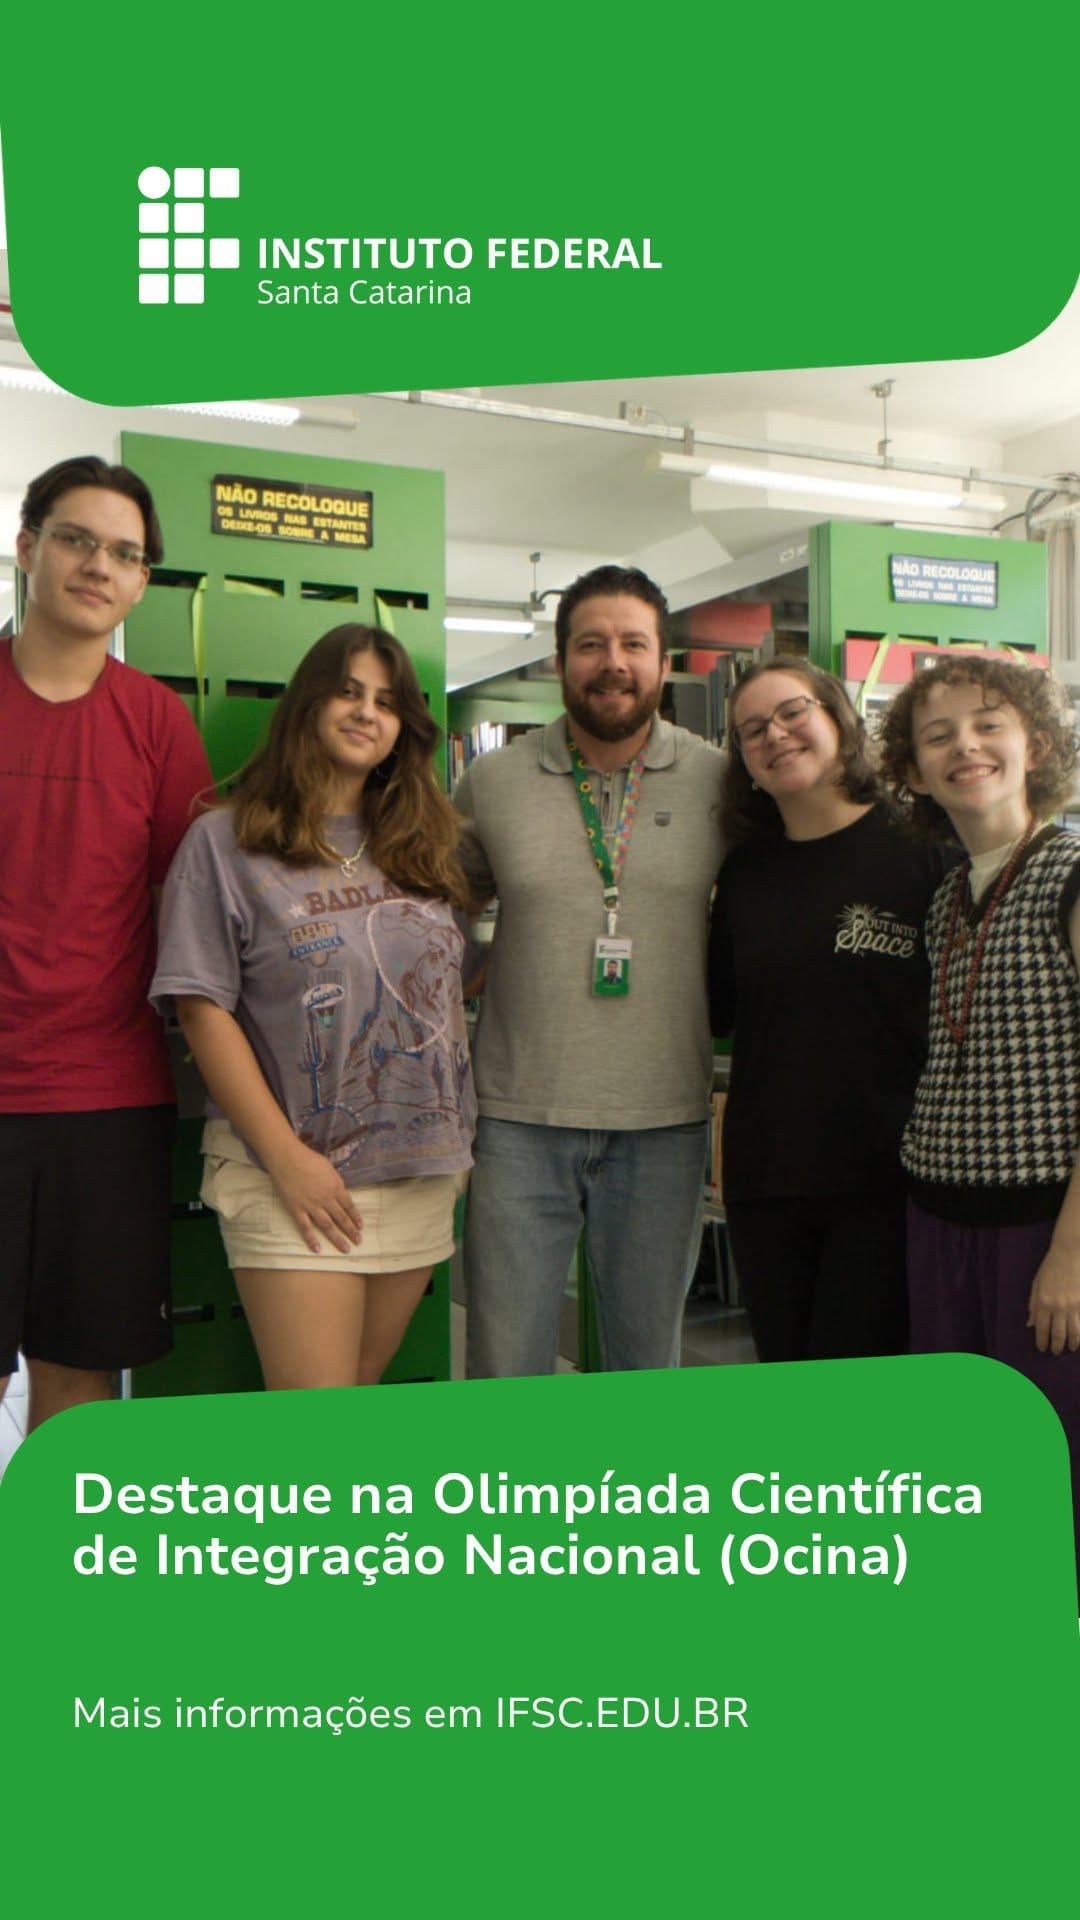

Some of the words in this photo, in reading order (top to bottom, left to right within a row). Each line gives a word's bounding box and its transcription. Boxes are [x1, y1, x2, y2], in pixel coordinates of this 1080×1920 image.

[216, 482, 257, 504] NÃO
[262, 490, 369, 518] RECOLOQUE
[217, 505, 233, 517] OS
[239, 507, 278, 522] LIVROS
[284, 513, 307, 525] NAS
[313, 516, 367, 532] ESTANTES
[221, 518, 272, 534] DEIXE-OS
[278, 525, 315, 539] SOBRE
[320, 530, 329, 541] A
[334, 532, 367, 544] MESA
[892, 560, 919, 577] NÃO
[922, 564, 995, 583] RECOLOQUE
[304, 879, 401, 916] BADLA
[834, 919, 914, 958] Space
[865, 918, 889, 932] OUT
[891, 922, 918, 938] INTO
